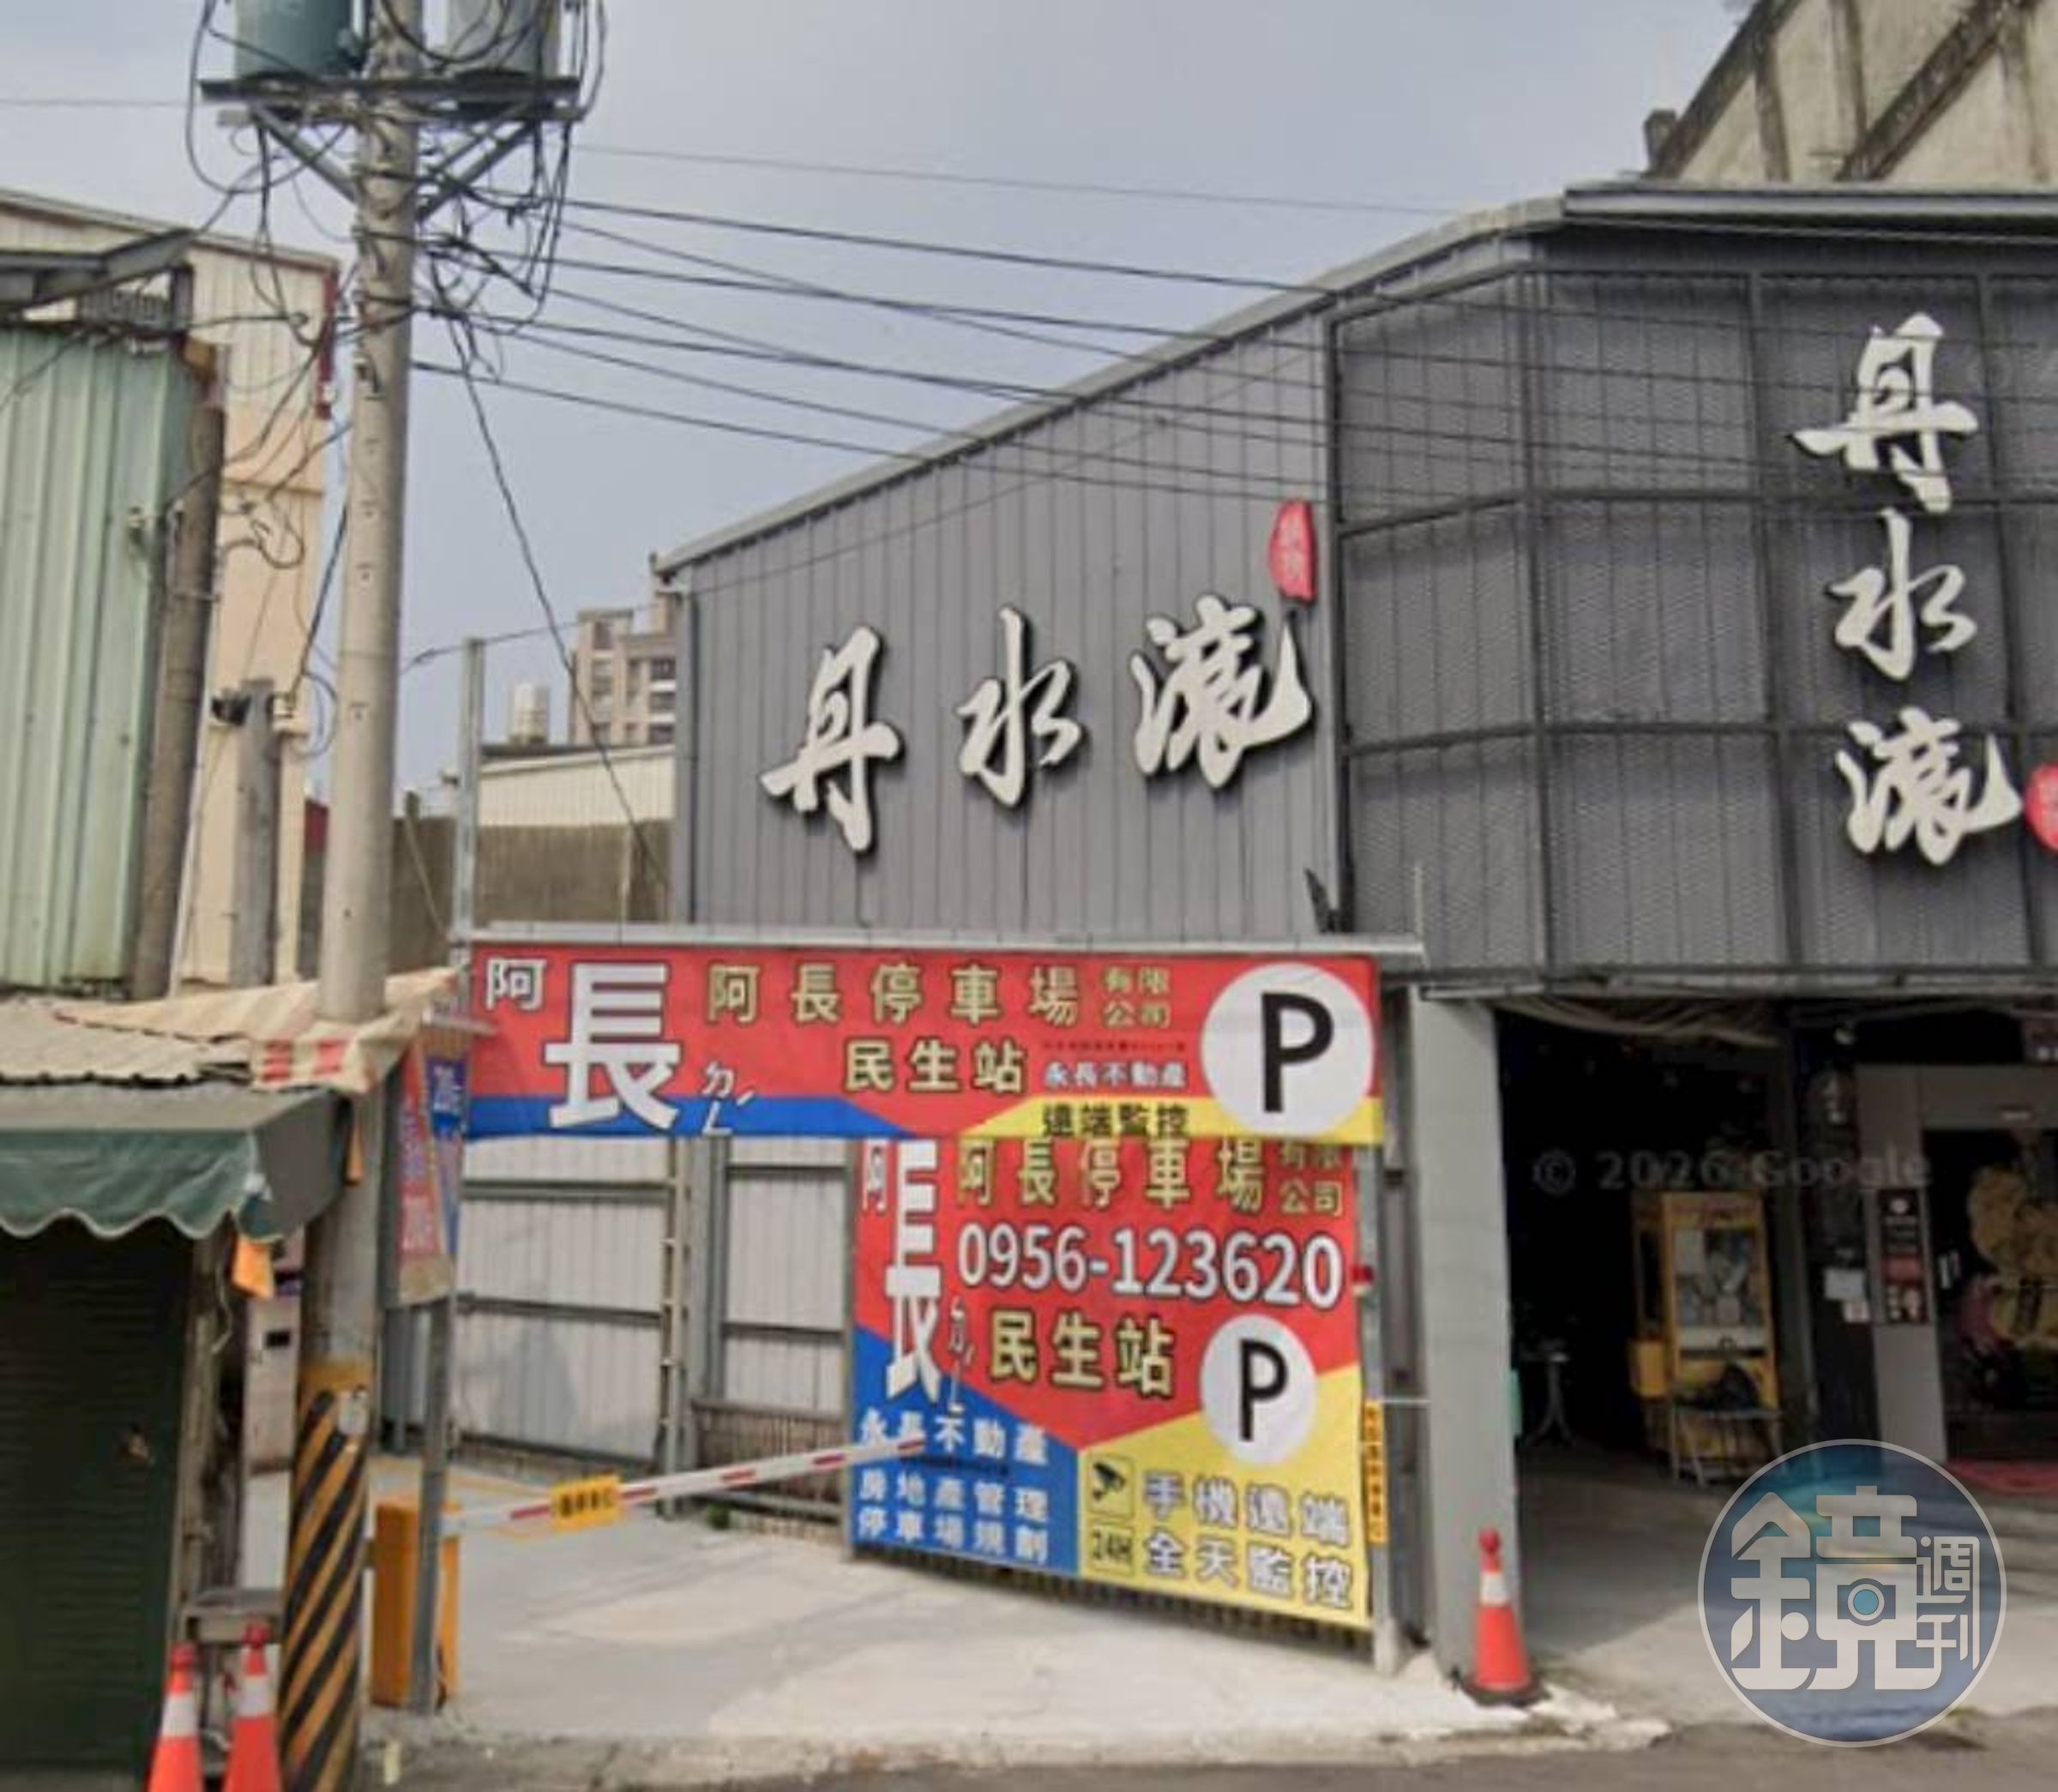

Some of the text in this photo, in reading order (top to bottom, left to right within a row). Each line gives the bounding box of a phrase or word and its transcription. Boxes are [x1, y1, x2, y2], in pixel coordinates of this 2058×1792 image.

[707, 962, 1079, 1027] 阿長停車場
[846, 1037, 1026, 1093] 民生站
[1262, 992, 1334, 1114] P
[958, 1137, 1264, 1212] 阿長停車場
[1279, 1178, 1344, 1217] 公司
[957, 1222, 1345, 1311] 0956-123620
[990, 1308, 1175, 1398] 民生站
[1240, 1338, 1289, 1443] P
[1145, 1470, 1351, 1548] 手機遠端
[1146, 1530, 1353, 1610] 全天監控
